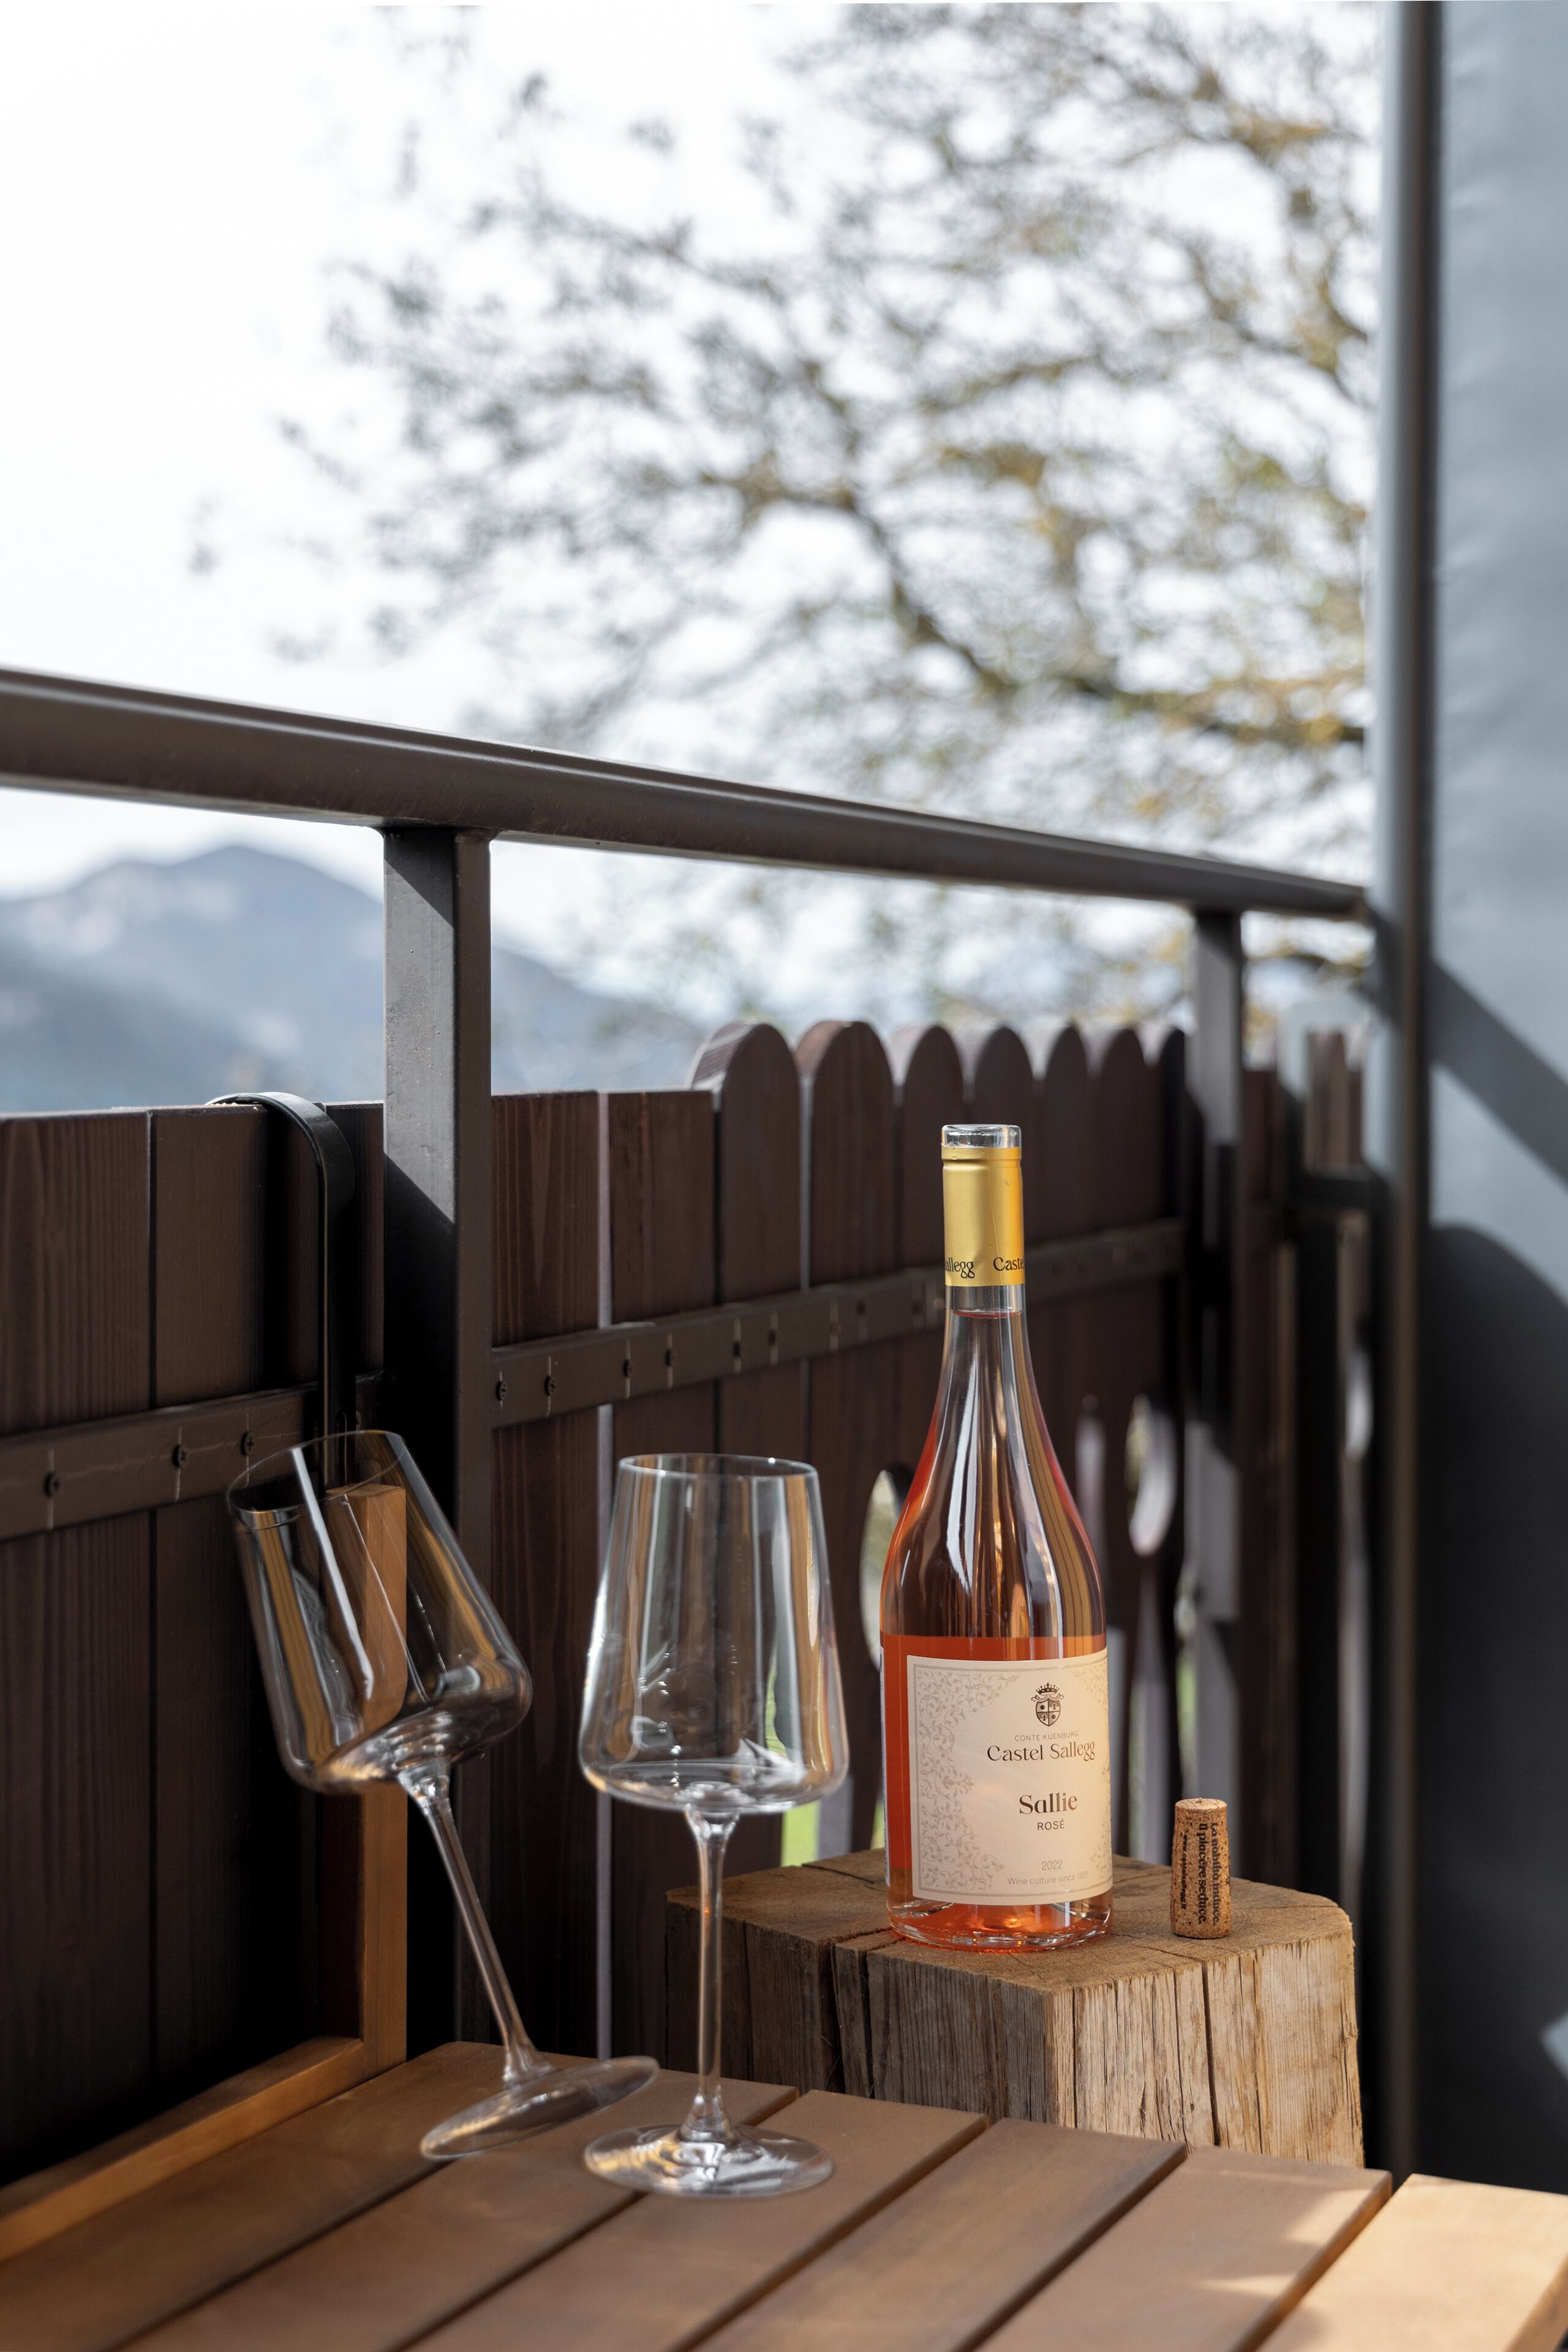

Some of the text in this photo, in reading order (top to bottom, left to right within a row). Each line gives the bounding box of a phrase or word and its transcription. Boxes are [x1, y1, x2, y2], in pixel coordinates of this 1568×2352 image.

[944, 1257, 1024, 1278] allegg Caste
[1043, 1730, 1079, 1740] KUENBURG
[987, 1741, 1095, 1762] Castel Sallegg
[1019, 1792, 1078, 1814] Sallie
[1037, 1819, 1065, 1831] ROSÉ
[1041, 1860, 1063, 1871] 2022
[1029, 1875, 1057, 1885] culture
[1058, 1874, 1076, 1883] since
[1077, 1871, 1089, 1879] 1851
